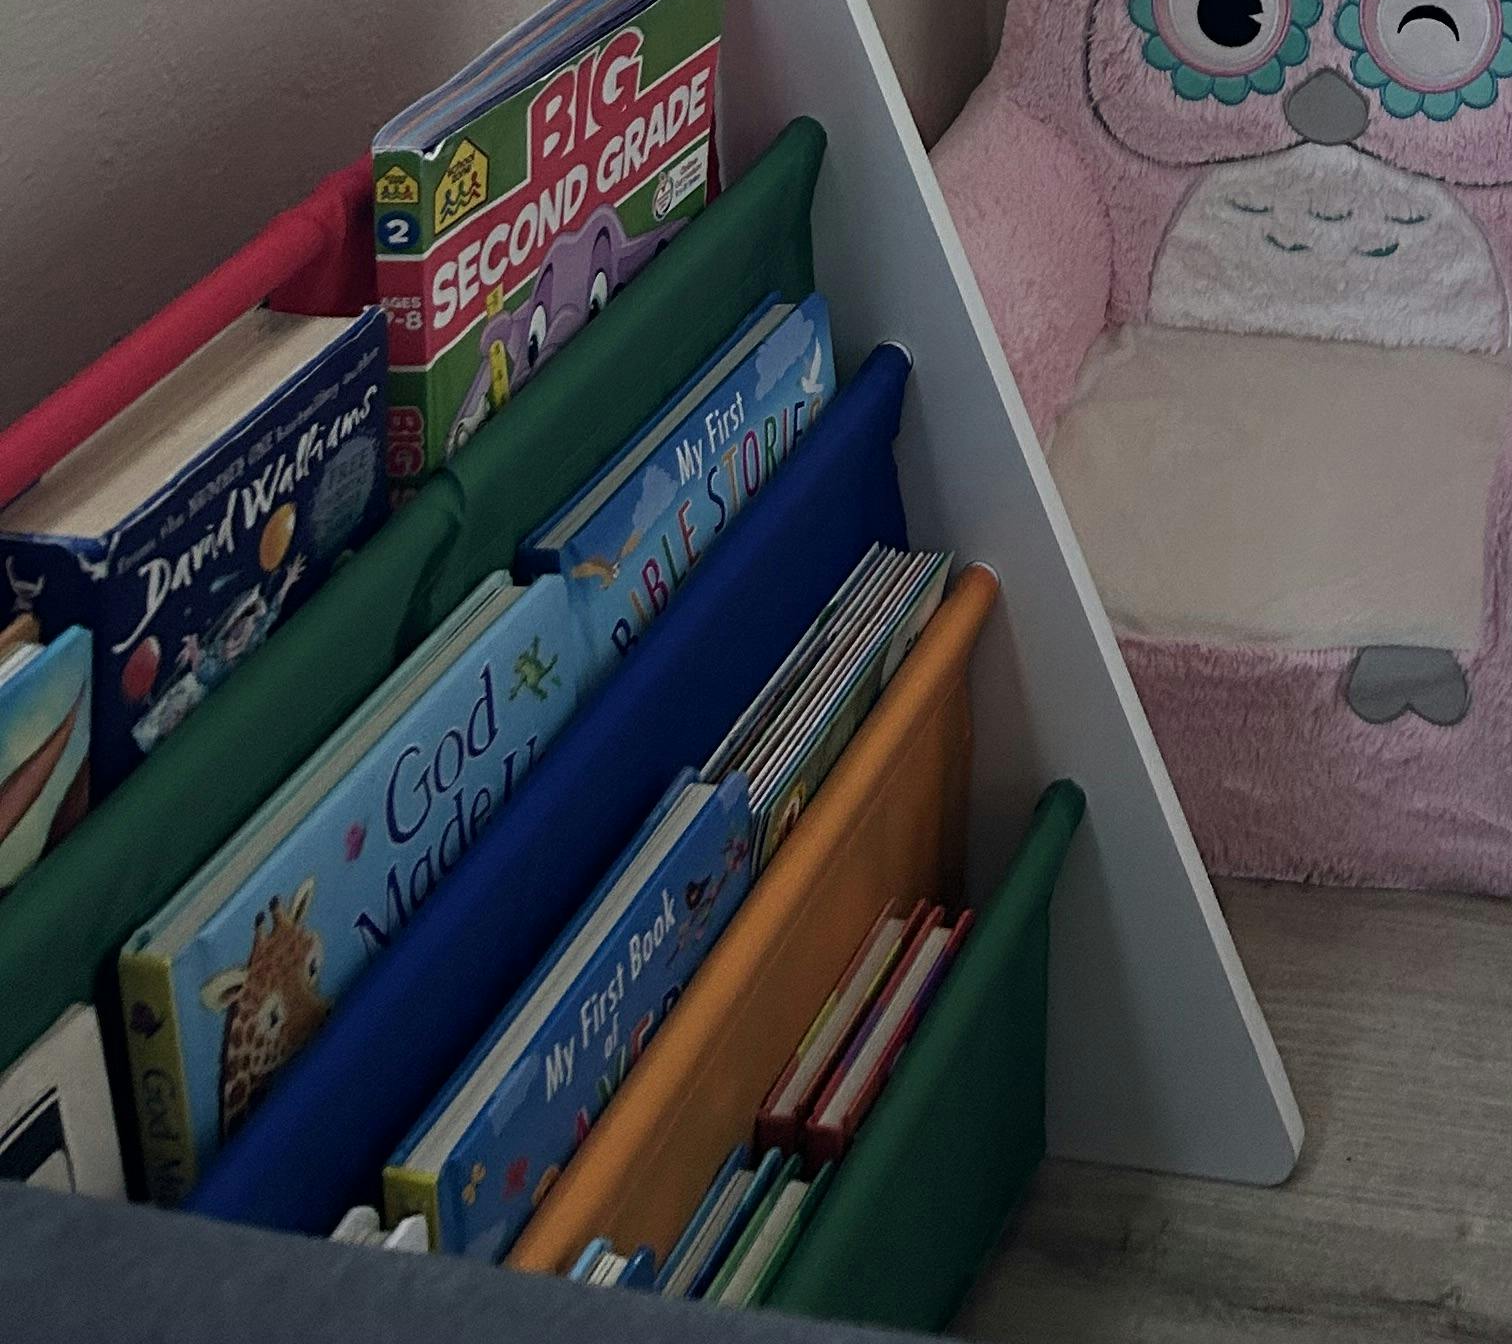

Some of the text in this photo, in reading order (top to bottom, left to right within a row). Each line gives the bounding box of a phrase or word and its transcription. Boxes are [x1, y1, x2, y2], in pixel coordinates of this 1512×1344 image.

[530, 25, 645, 162] BIG
[385, 218, 409, 244] 2
[432, 67, 711, 330] SECOND GRADE
[110, 487, 238, 656] David
[240, 383, 379, 530] Walliams
[676, 390, 745, 486] My First
[386, 662, 499, 845] God
[352, 787, 492, 954] Made
[545, 1035, 576, 1103] My
[579, 961, 625, 1050] First
[628, 887, 677, 981] Book
[604, 1011, 621, 1061] of
